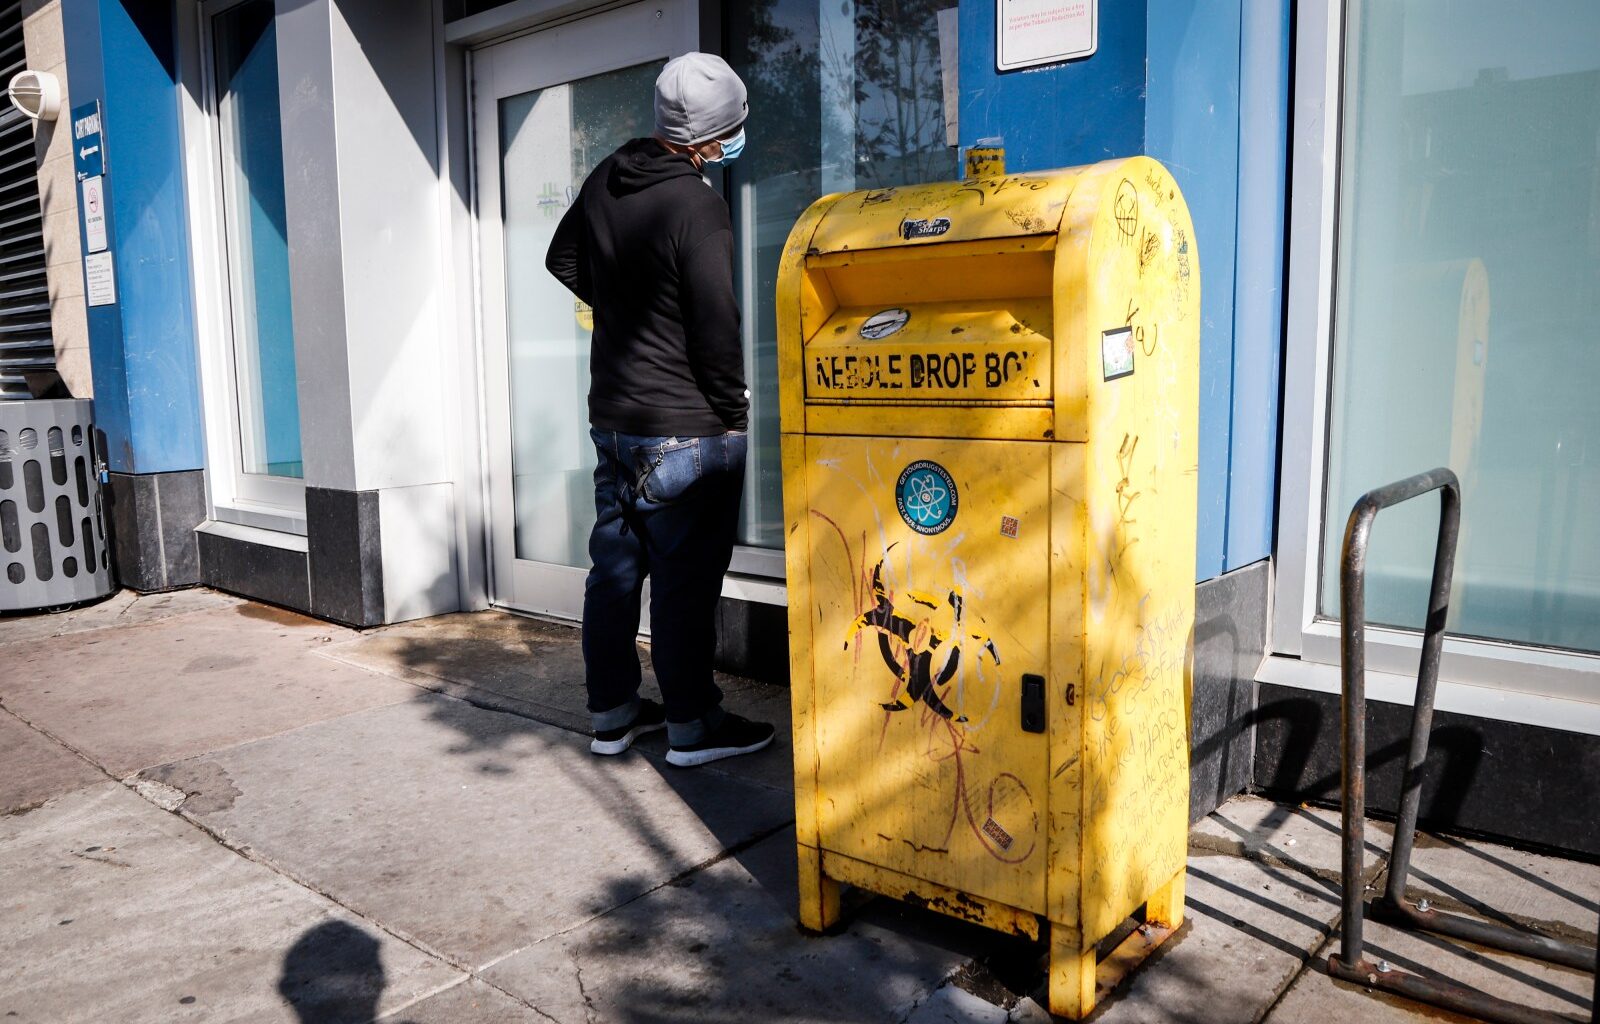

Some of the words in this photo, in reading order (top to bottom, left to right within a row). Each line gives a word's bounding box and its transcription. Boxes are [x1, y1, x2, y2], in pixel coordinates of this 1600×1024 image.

[912, 220, 941, 228] Sece
[918, 226, 947, 234] Sharps
[816, 354, 903, 389] NEEDLE
[910, 352, 976, 389] DROP
[985, 351, 1041, 389] BO
[900, 462, 957, 506] GETYOURDRUGSTESTED.COM
